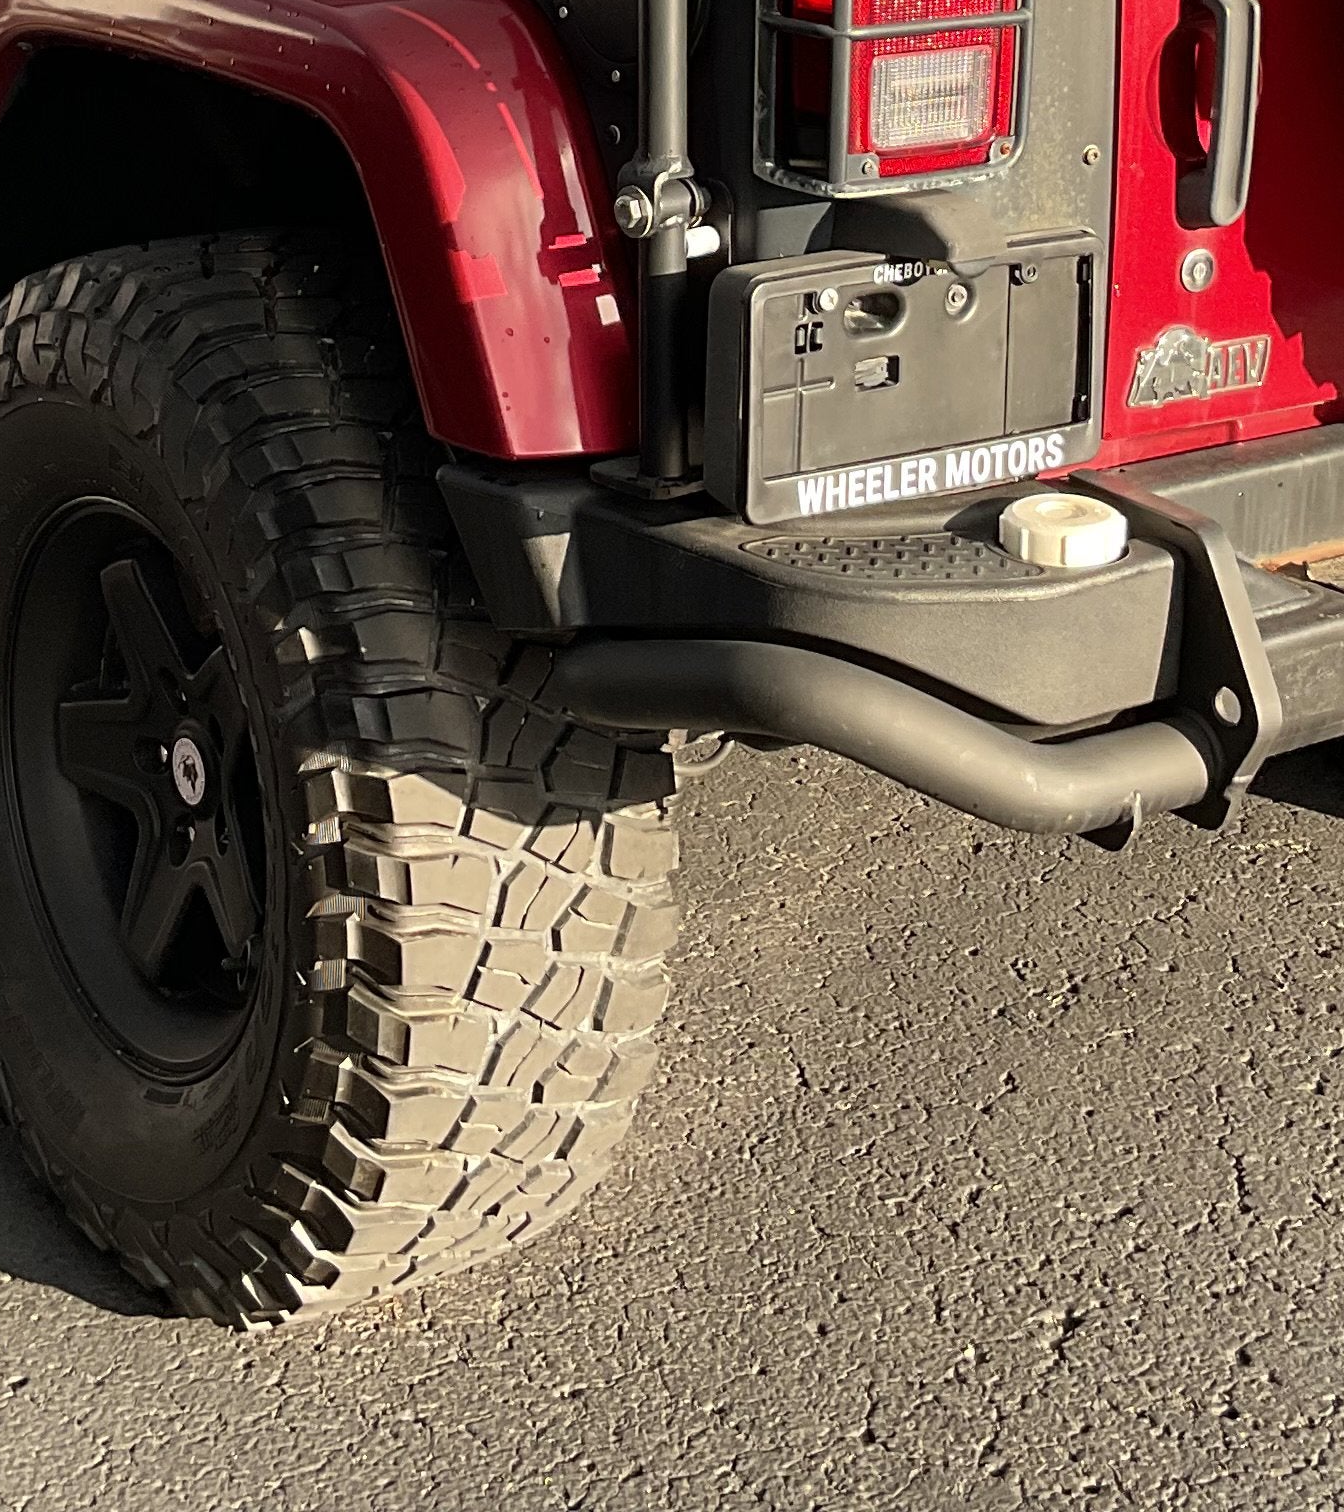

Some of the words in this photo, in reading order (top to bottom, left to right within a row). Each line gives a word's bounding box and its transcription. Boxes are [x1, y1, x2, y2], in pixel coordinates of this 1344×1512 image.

[873, 260, 948, 285] CHEBO
[1207, 340, 1268, 389] AEV
[796, 457, 937, 516] WHEELER
[945, 433, 1066, 489] MOTORS
